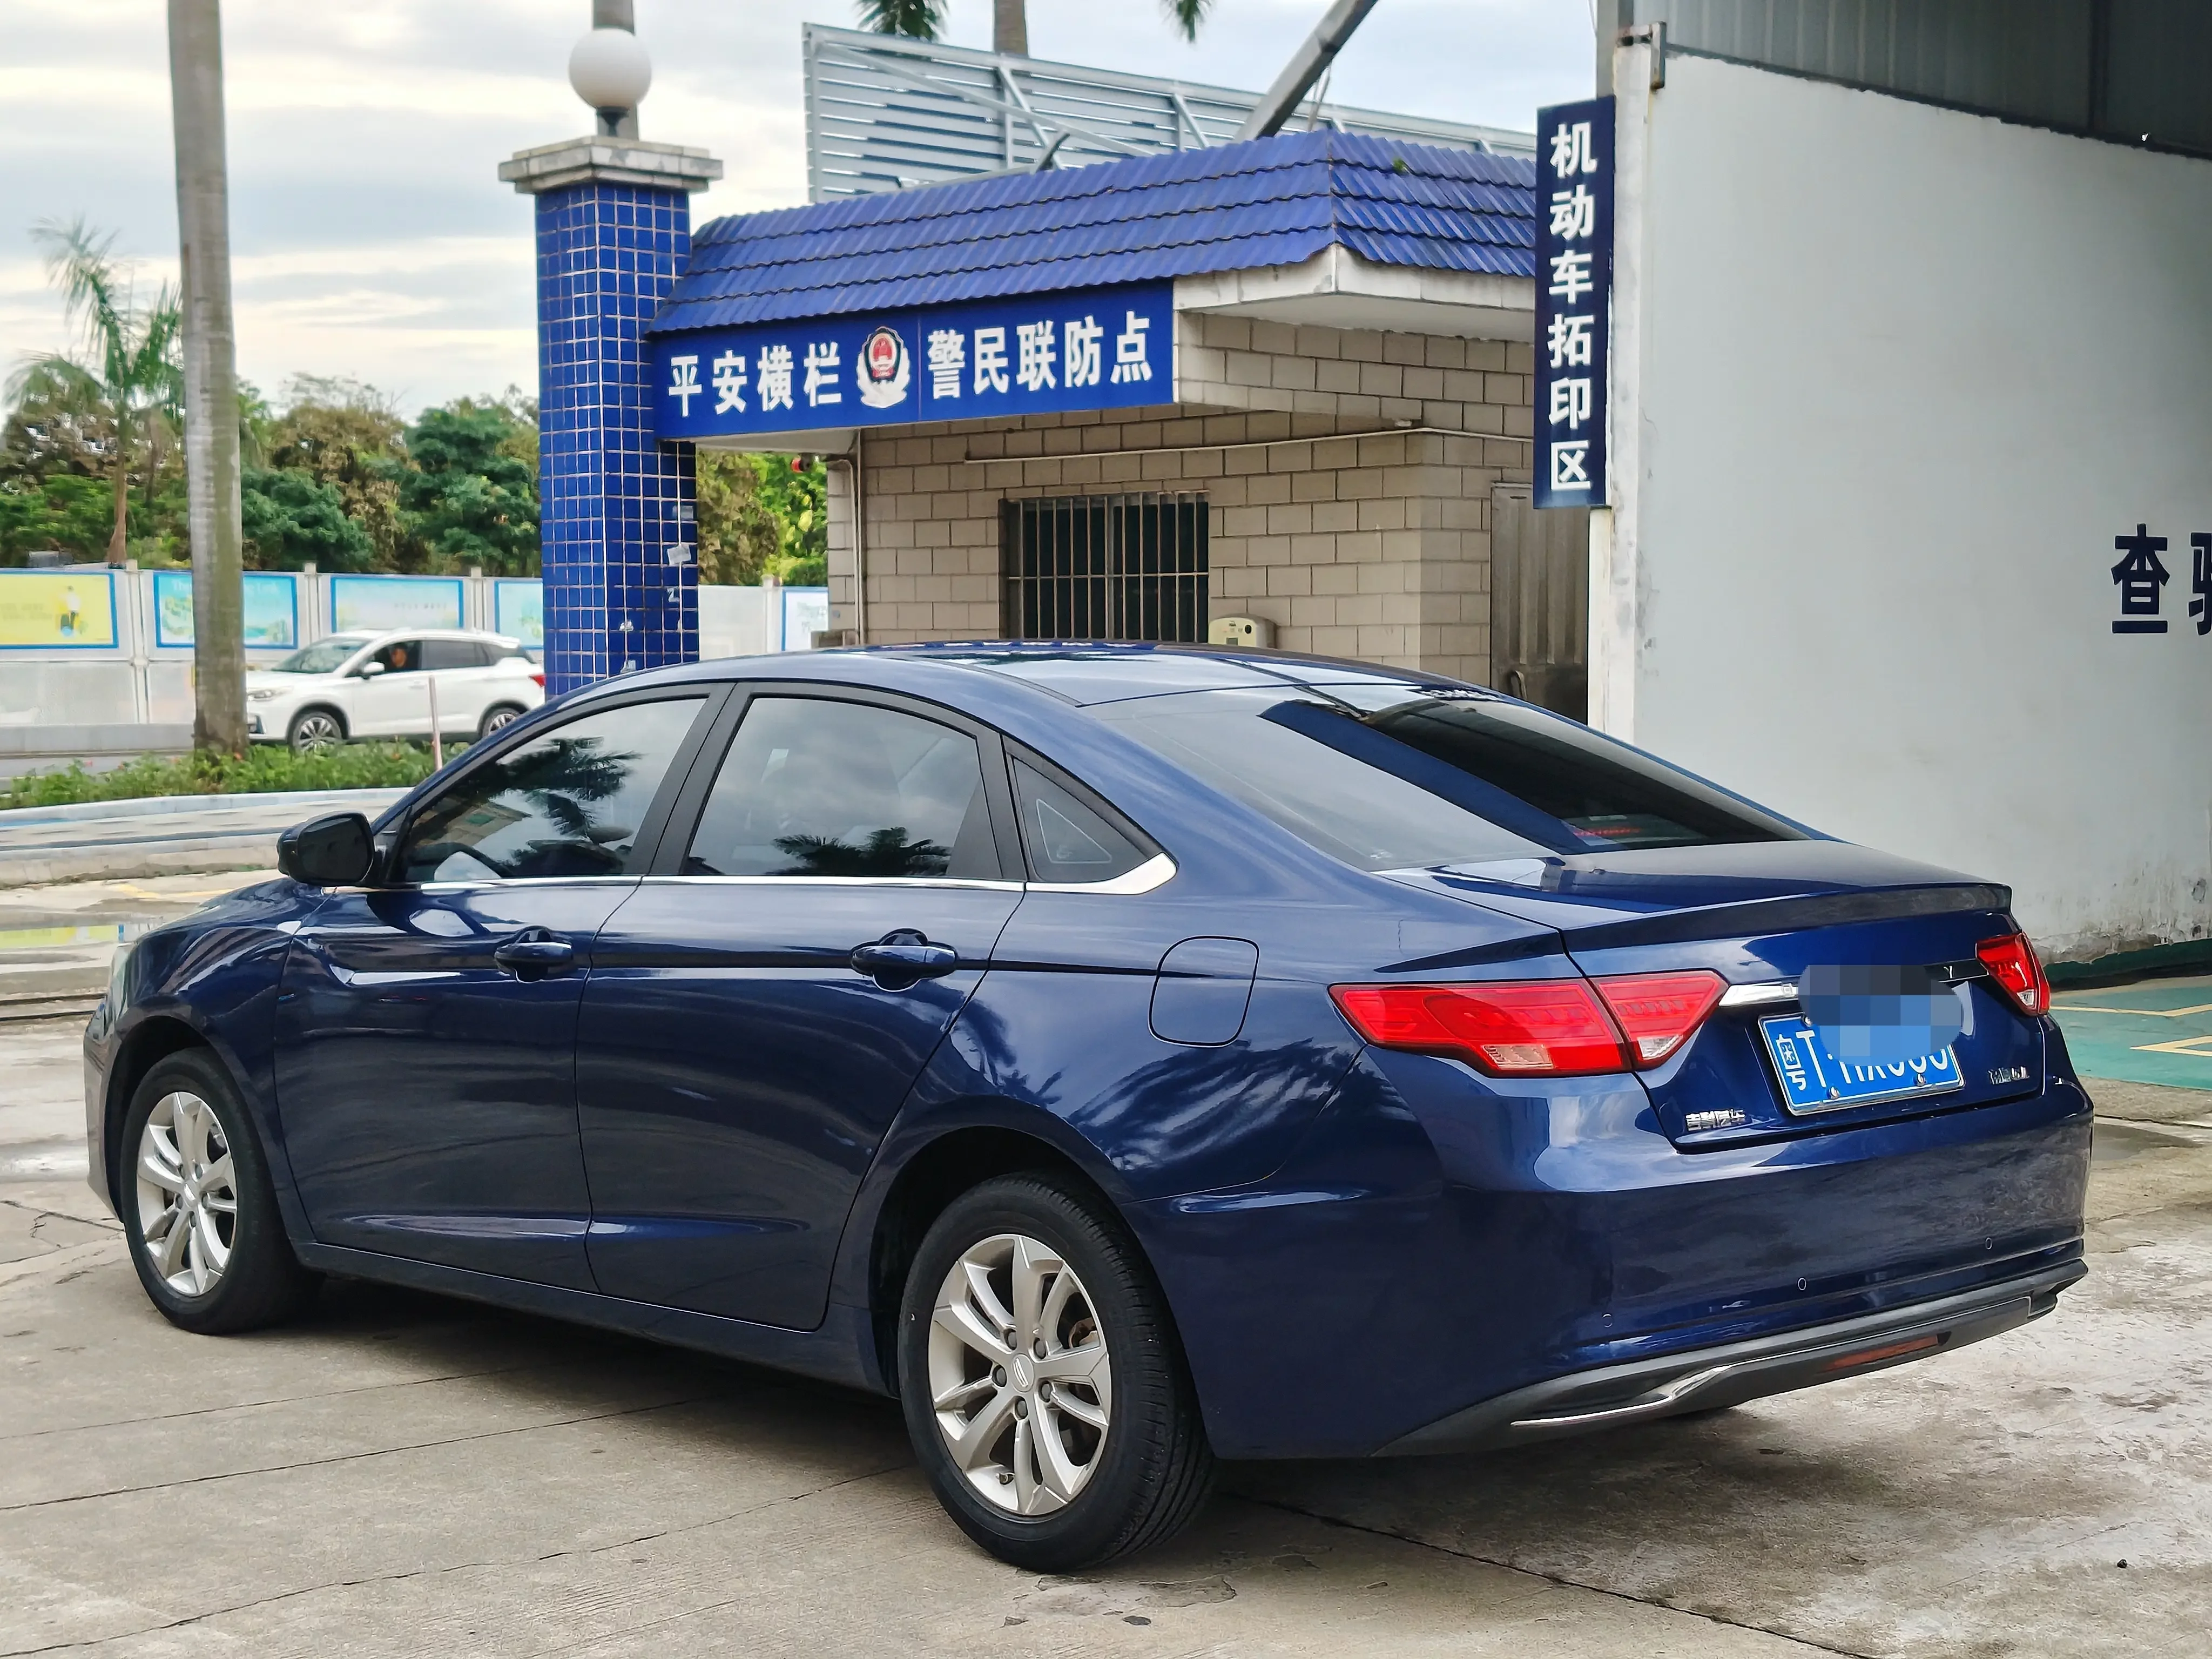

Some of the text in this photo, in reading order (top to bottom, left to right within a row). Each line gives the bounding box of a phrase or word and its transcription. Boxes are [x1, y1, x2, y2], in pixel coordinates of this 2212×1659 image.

[668, 311, 1152, 417] 平安横栏 警民联防点
[1548, 122, 1597, 490] 机动车拓印区
